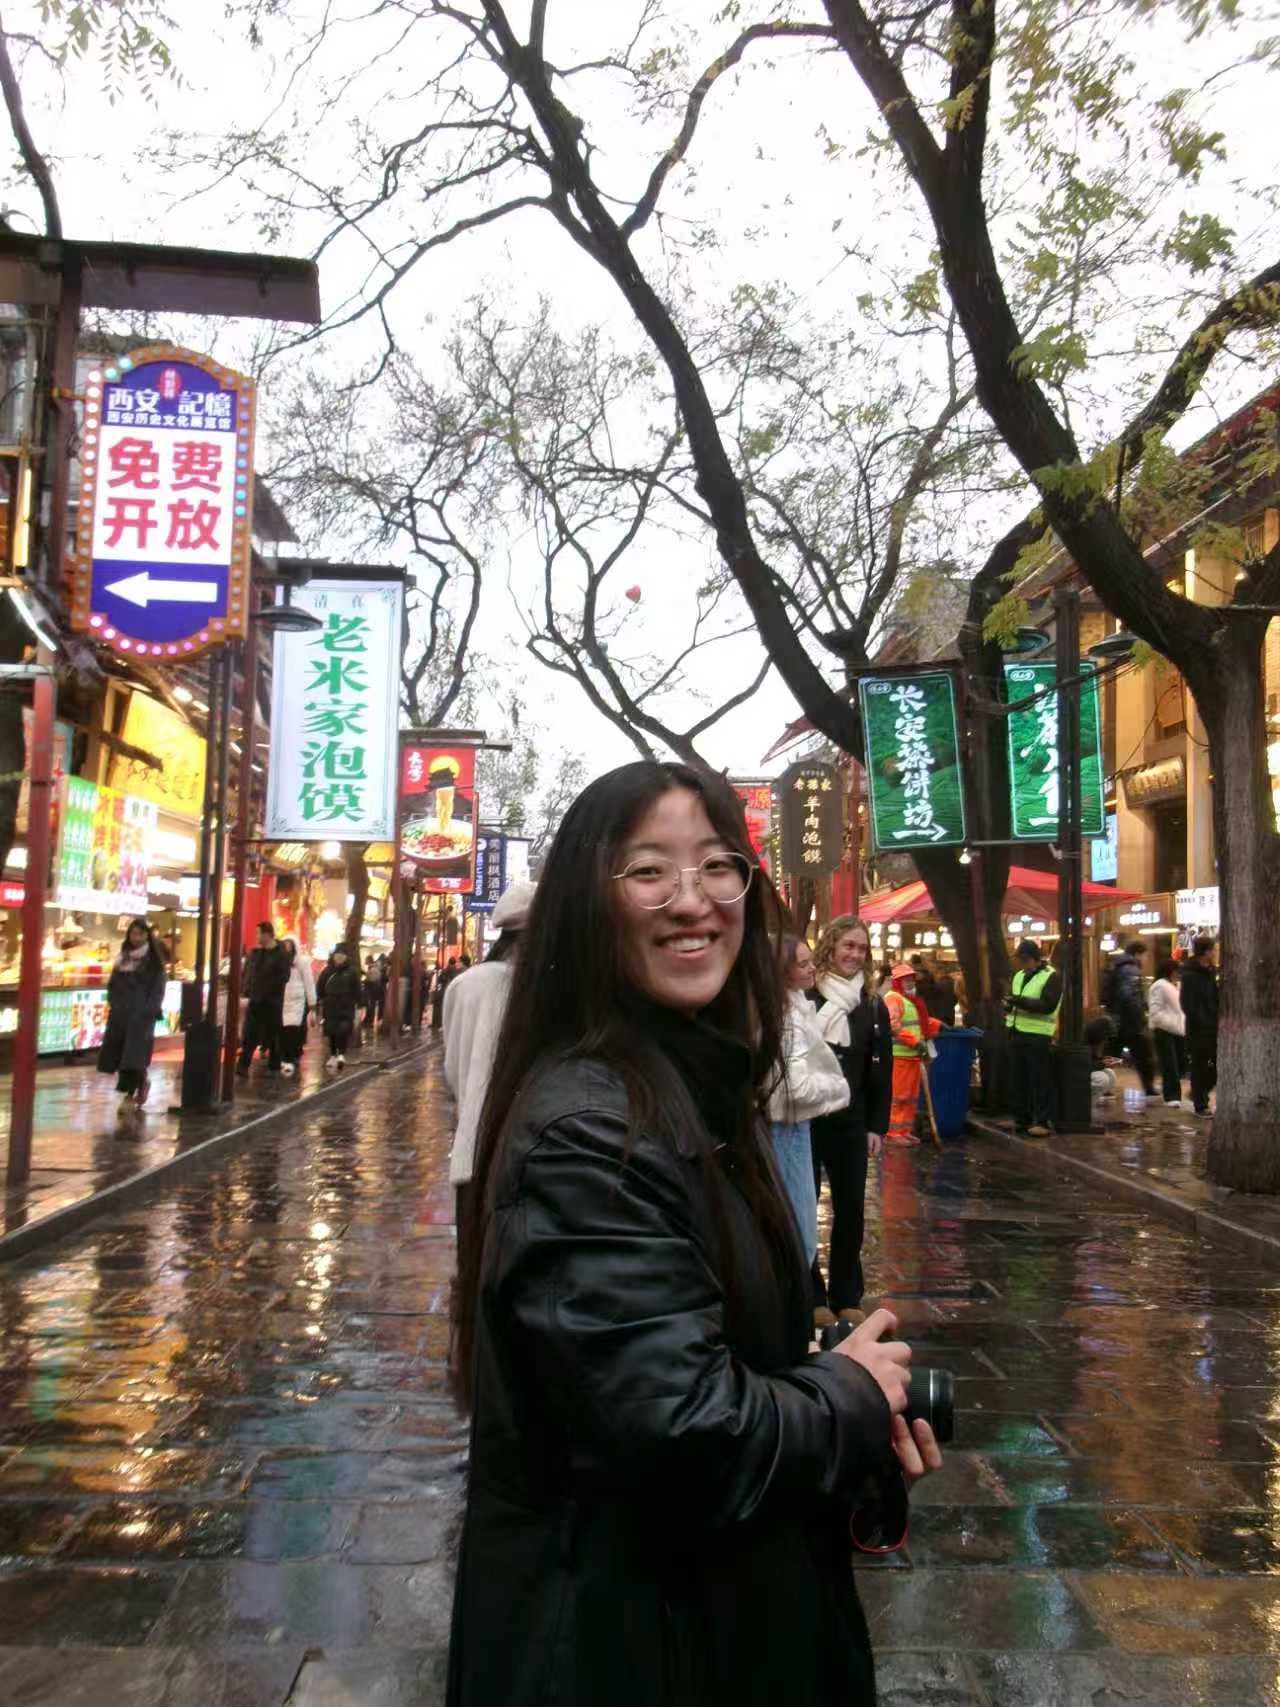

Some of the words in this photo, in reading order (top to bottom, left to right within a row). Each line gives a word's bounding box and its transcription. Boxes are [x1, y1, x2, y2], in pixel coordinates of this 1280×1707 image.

[108, 437, 223, 494] 免费
[103, 497, 222, 551] 开放
[298, 613, 373, 824] 老米家泡馍
